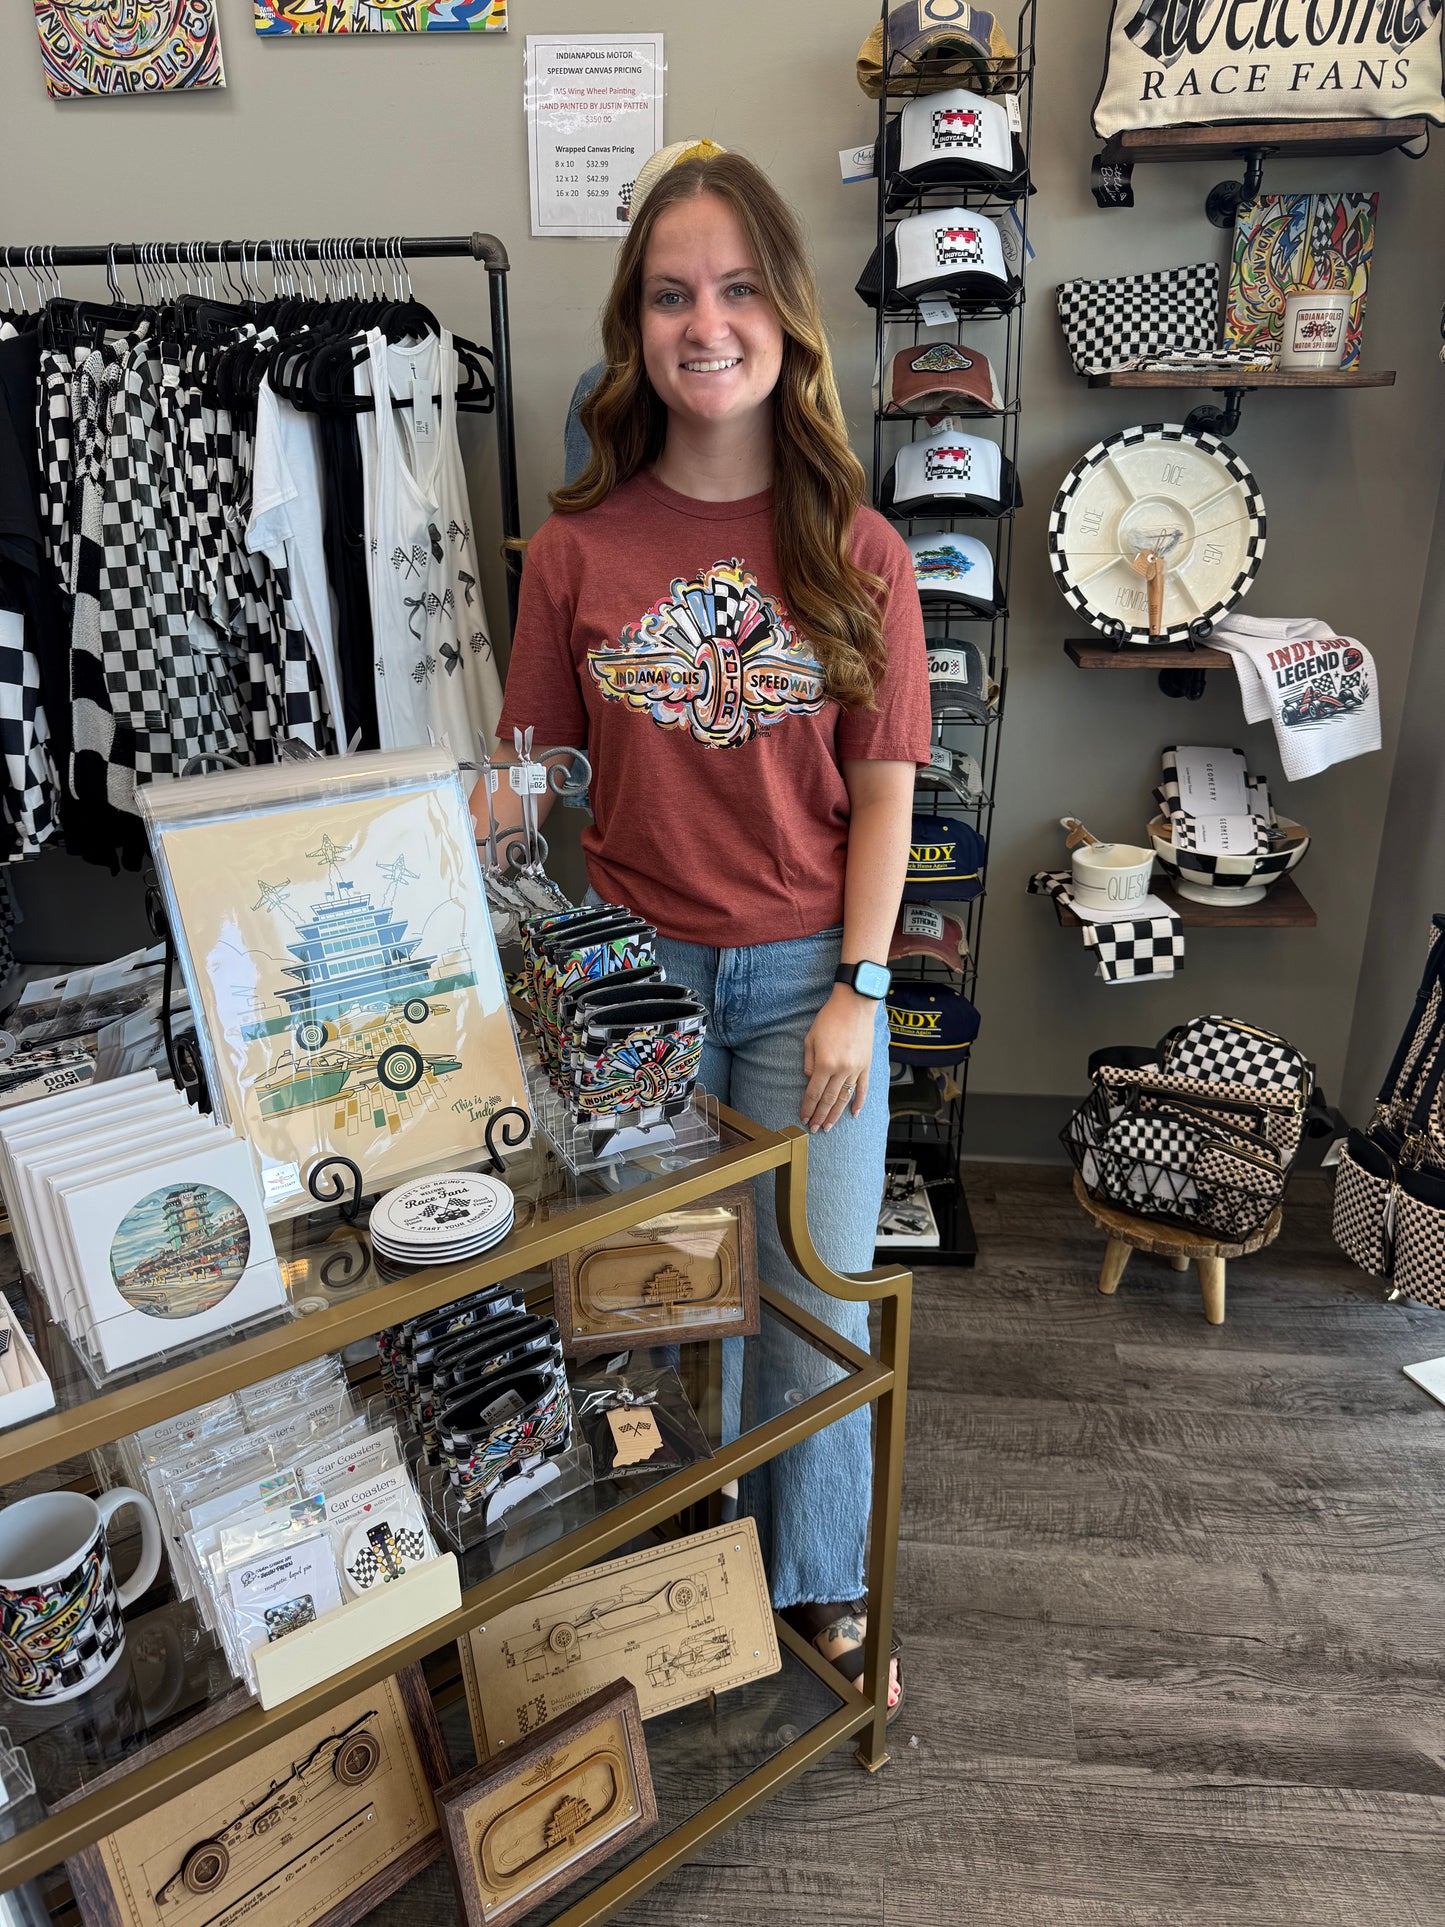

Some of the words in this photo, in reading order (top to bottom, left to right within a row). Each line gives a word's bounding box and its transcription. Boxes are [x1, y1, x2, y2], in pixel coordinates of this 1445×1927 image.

[556, 52, 605, 60] INDIANAPOLIS
[547, 67, 584, 75] SPEEDWAY
[614, 66, 642, 74] PRICING
[1139, 64, 1270, 101] RACE
[1287, 59, 1411, 92] FANS
[554, 87, 567, 95] IMS
[568, 87, 585, 97] Wing
[586, 87, 608, 95] Wheel
[609, 87, 636, 97] Painting
[539, 102, 559, 110] HAND
[560, 102, 588, 110] PAINTED
[589, 102, 599, 110] BY
[599, 102, 622, 110] JUSTIN
[623, 102, 648, 110] PATTEN
[585, 115, 612, 124] $350.00
[940, 135, 964, 143] INDYCAR
[555, 146, 586, 155] Wrapped
[611, 145, 635, 155] Pricing
[586, 160, 609, 168] $32.99
[586, 175, 609, 183] $42.99
[587, 189, 609, 198] $62.99
[944, 251, 968, 259] INDYCAR
[1253, 227, 1281, 309] INDIANAPOLIS
[1298, 312, 1344, 321] INDIANAPOLIS
[1161, 464, 1187, 487] DICE
[1080, 510, 1105, 537] SLICE
[1203, 543, 1225, 566] VEG
[1115, 587, 1148, 613] RUNCH
[1266, 640, 1316, 671] INDY
[1275, 651, 1340, 689] LEGEND
[615, 669, 700, 686] INDIANAPOLIS
[722, 649, 735, 720] MOTOR
[750, 674, 815, 695] SPEEDWAY
[1206, 763, 1217, 802] GEOMETRY
[1219, 818, 1230, 850] GEOMETRY
[910, 908, 938, 921] AMERICA
[911, 917, 937, 928] STRONG
[43, 1071, 76, 1087] 500
[47, 1076, 80, 1093] INDY
[584, 1081, 642, 1106] INDIANAPOLIS
[649, 1066, 664, 1093] MOTOR
[669, 1052, 702, 1075] SPEEDW
[451, 1098, 473, 1114] This
[474, 1095, 482, 1104] is
[467, 1101, 495, 1123] Indy
[404, 1197, 438, 1209] Race
[437, 1187, 470, 1199] Fans
[420, 1187, 445, 1197] WELCOME
[445, 1222, 465, 1230] YOUR
[154, 1426, 174, 1439] Car
[317, 1463, 336, 1475] Car
[337, 1441, 382, 1465] Coasters
[330, 1500, 350, 1513] Car
[351, 1477, 397, 1502] Coasters
[3, 1640, 31, 1676] OTOR
[26, 1606, 82, 1650] SPEEDWAY
[256, 1810, 282, 1836] 82
